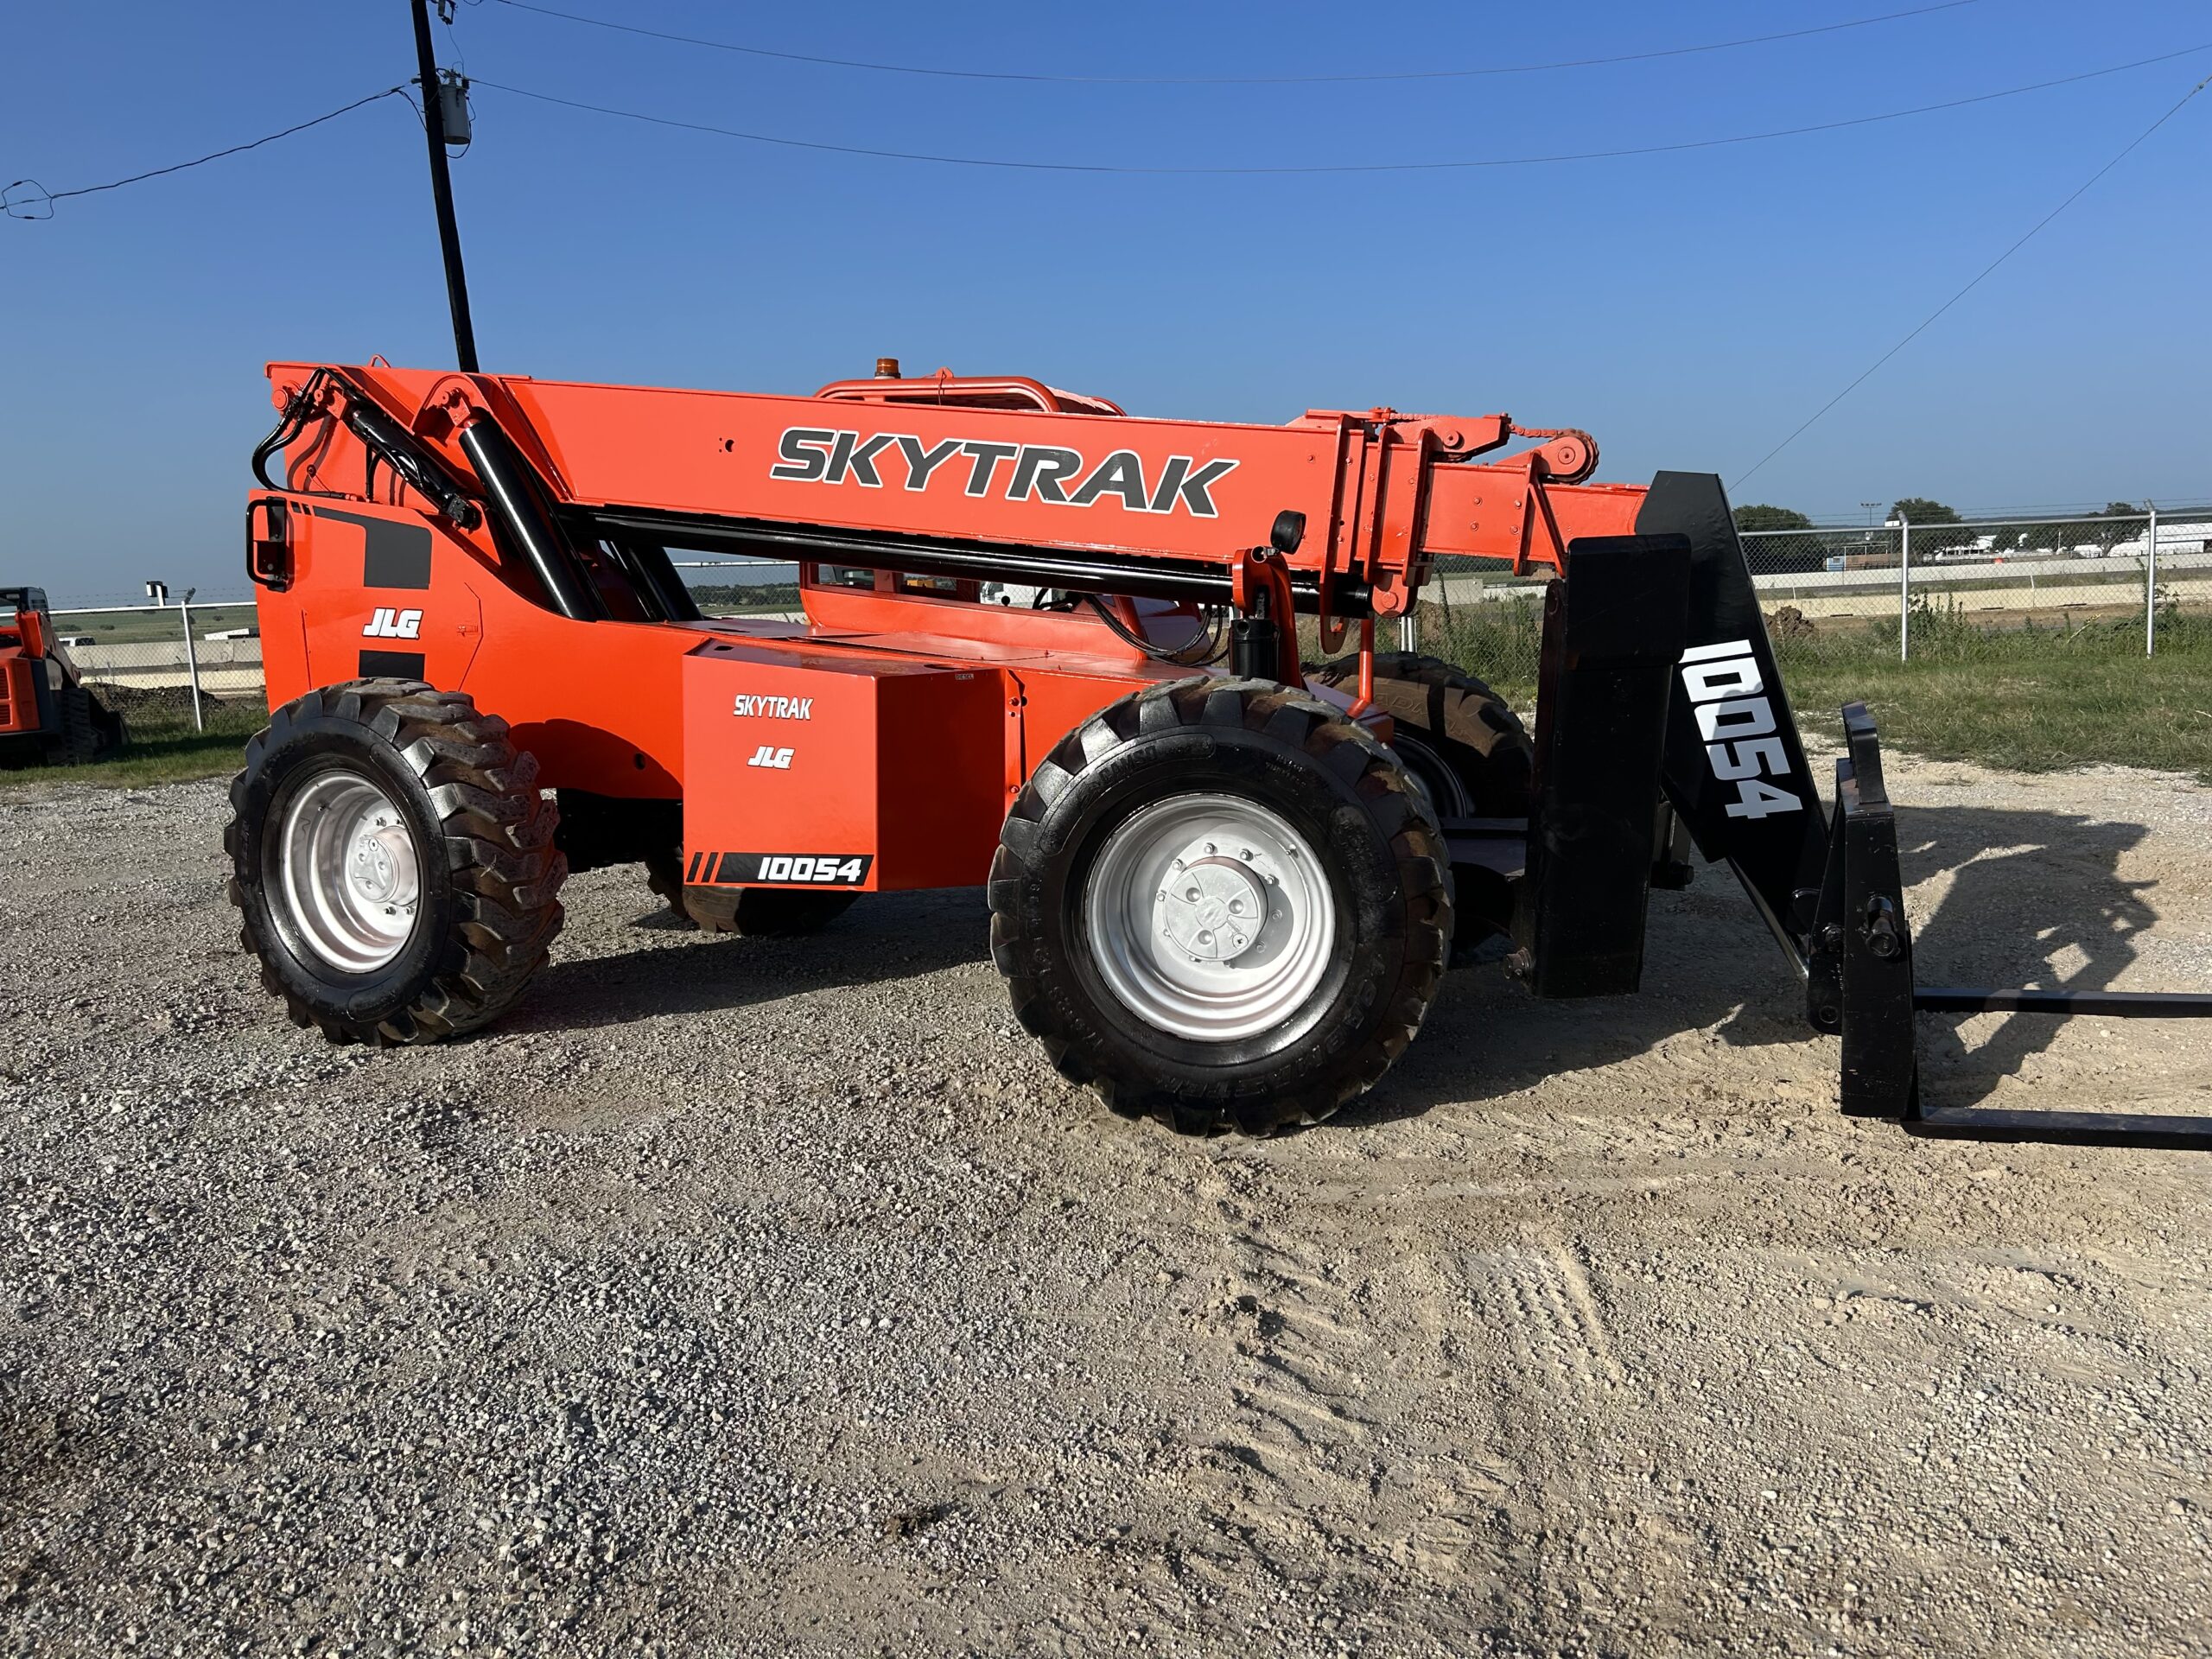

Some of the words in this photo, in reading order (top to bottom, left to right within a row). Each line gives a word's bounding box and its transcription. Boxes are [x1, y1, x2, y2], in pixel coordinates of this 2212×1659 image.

[770, 426, 1241, 518] SKYTRAK
[362, 607, 423, 639] JLG
[734, 695, 814, 720] SKYTRAK
[1678, 639, 1803, 819] 10054
[747, 745, 795, 770] JLG
[757, 856, 862, 882] 10054
